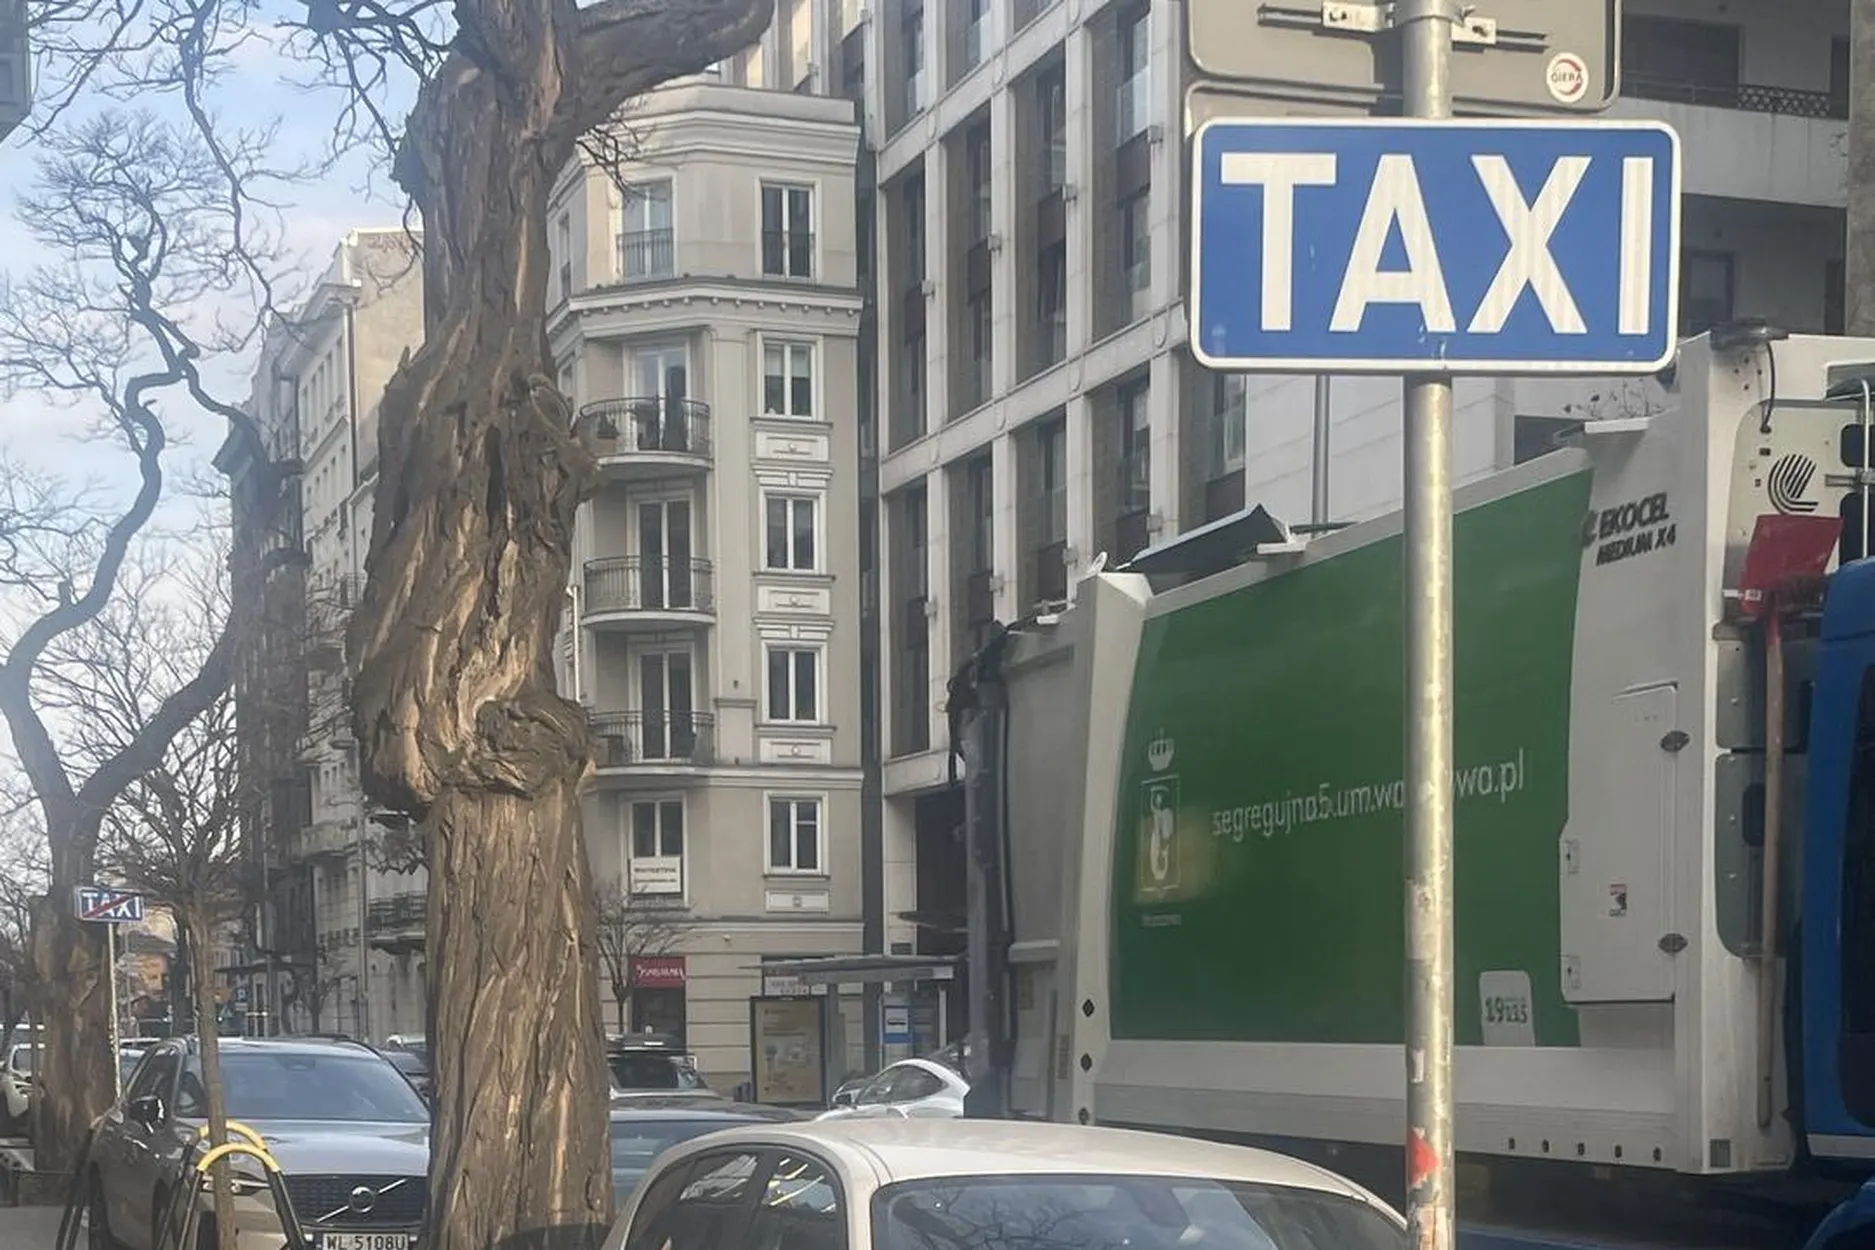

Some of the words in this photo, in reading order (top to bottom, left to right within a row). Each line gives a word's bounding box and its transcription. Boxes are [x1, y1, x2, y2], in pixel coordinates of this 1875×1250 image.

[1220, 152, 1654, 335] TAXI
[82, 892, 141, 918] TAXI
[326, 1234, 347, 1250] WL
[354, 1234, 406, 1250] 5108U
